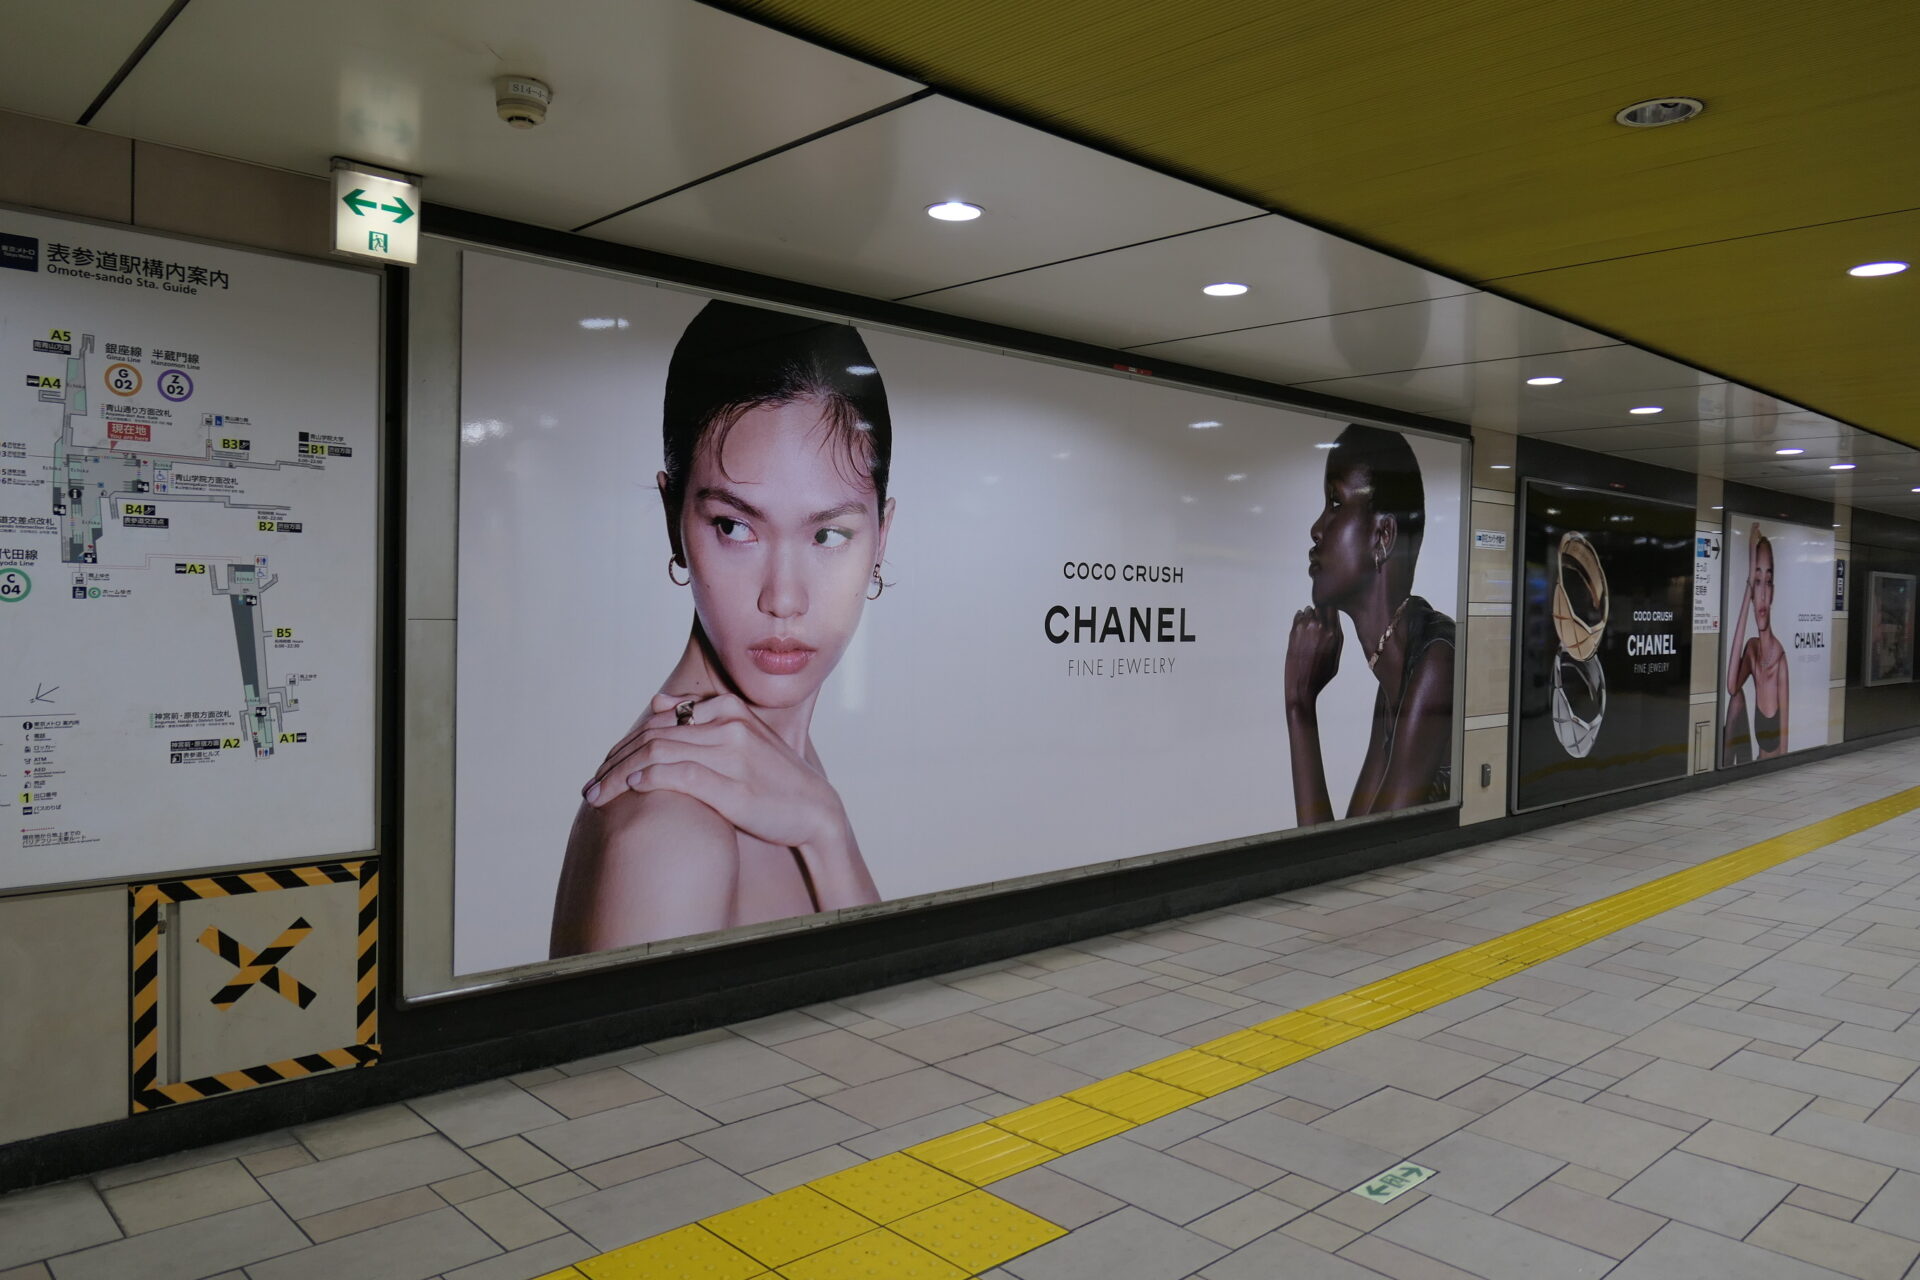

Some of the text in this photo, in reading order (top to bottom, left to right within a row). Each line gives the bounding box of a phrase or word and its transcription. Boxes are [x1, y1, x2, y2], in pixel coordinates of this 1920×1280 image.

[47, 243, 228, 290] 表参道駅構内案内
[47, 264, 197, 295] Omote-sando Sta. Guide
[51, 330, 71, 342] A5
[105, 343, 142, 357] 銀座線
[152, 349, 200, 364] 半蔵門線
[119, 369, 128, 378] G
[41, 377, 61, 388] A4
[114, 379, 132, 390] 02
[171, 375, 179, 384] Z
[167, 384, 184, 395] 02
[112, 424, 147, 436] 現在地
[222, 439, 238, 449] B3
[311, 445, 324, 455] B1
[126, 504, 143, 515] B4
[259, 521, 275, 531] B2
[188, 564, 206, 574] A3
[1064, 562, 1183, 583] COCO CRUSH
[7, 573, 16, 583] C
[1, 584, 21, 595] 04
[1633, 611, 1673, 621] COCO CRUSH
[1045, 605, 1196, 644] CHANEL
[276, 628, 292, 638] B5
[1627, 634, 1677, 656] CHANEL
[1794, 632, 1825, 649] CHANEL
[1068, 657, 1176, 678] FINE JEWELRY
[280, 733, 295, 743] A1
[223, 739, 240, 749] A2
[23, 793, 29, 803] 1
